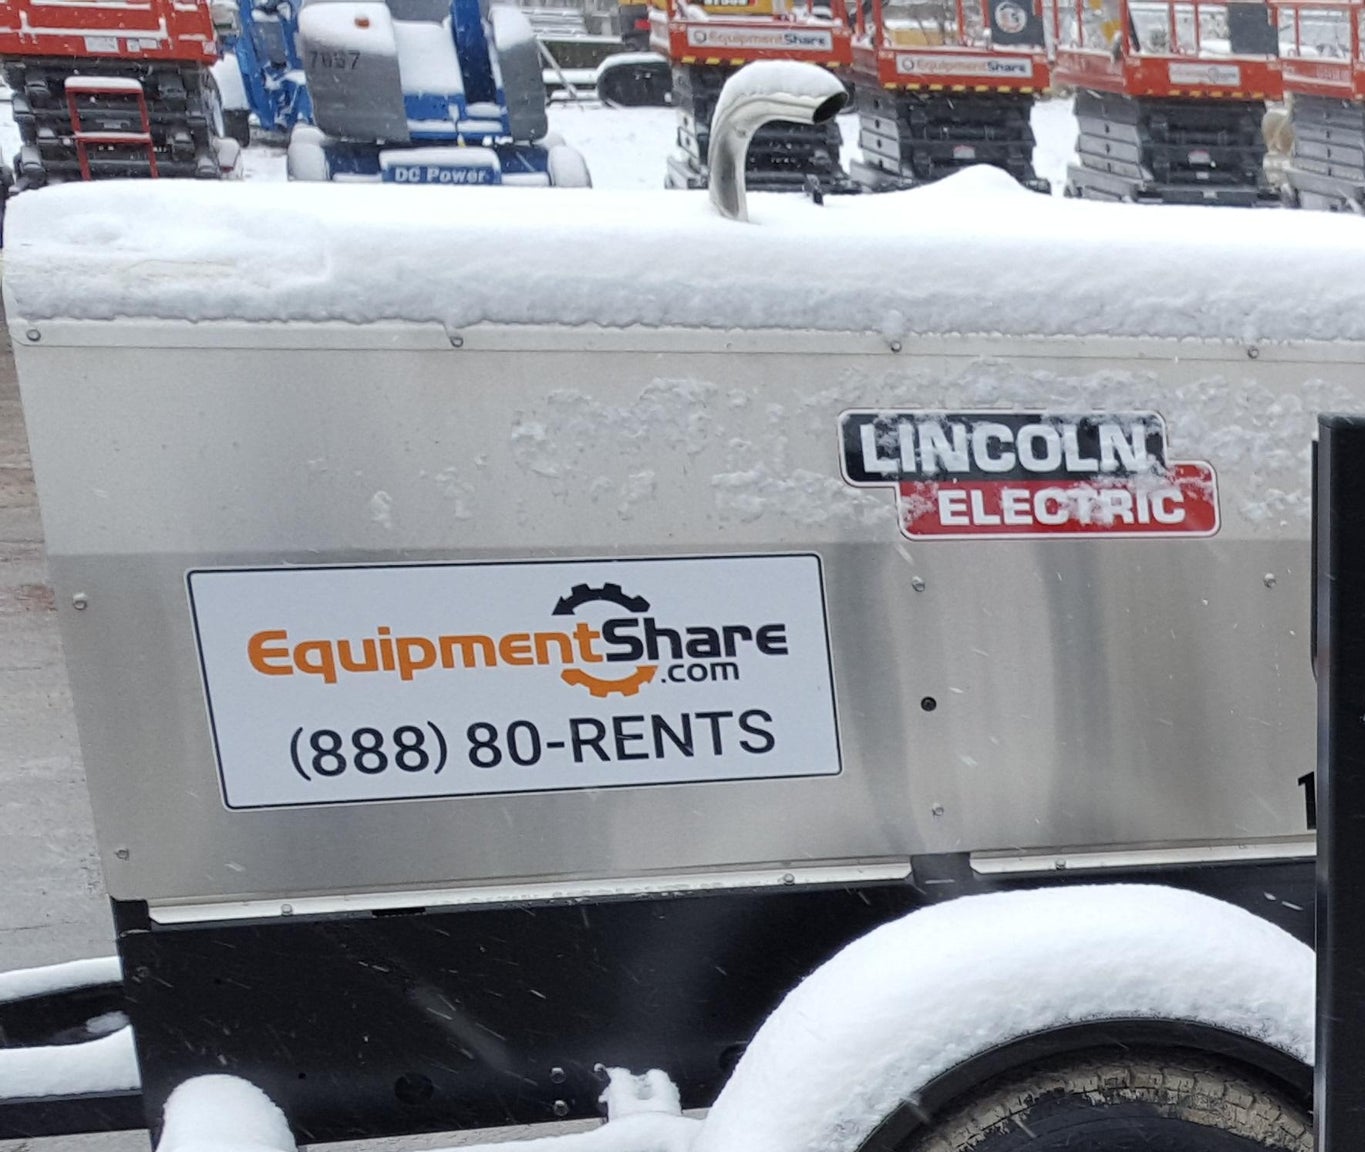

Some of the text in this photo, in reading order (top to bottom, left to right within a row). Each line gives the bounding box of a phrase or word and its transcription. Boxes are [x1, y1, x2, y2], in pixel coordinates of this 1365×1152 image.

[395, 166, 486, 184] DC Power
[859, 422, 1148, 474] LINCOLN
[937, 486, 1186, 526] ELECTRIC
[246, 616, 789, 684] EquipmentShare
[660, 658, 741, 684] .com
[289, 708, 777, 783] (888) 80-RENTS
